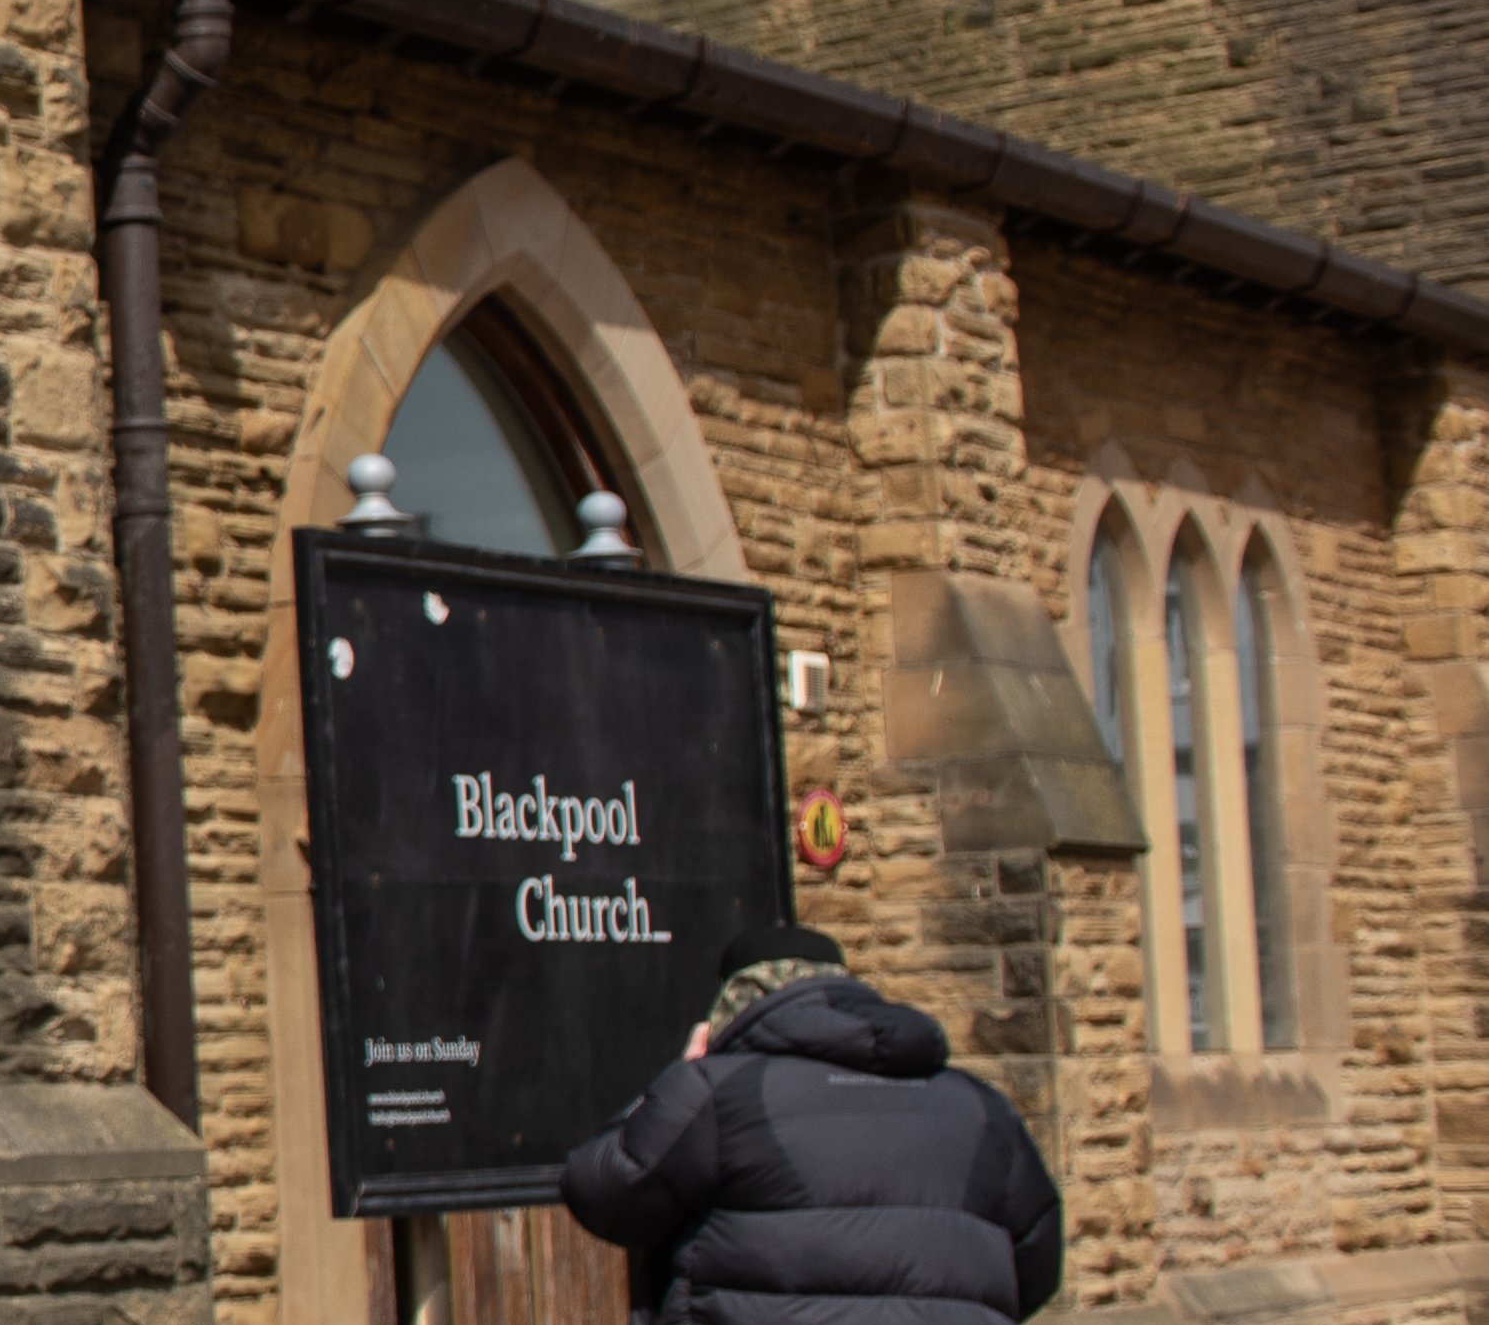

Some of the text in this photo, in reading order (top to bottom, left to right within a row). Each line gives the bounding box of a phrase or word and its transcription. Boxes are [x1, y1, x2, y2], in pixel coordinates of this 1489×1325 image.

[451, 770, 641, 861] Blackpool
[364, 1034, 482, 1067] Join us on Sunday
